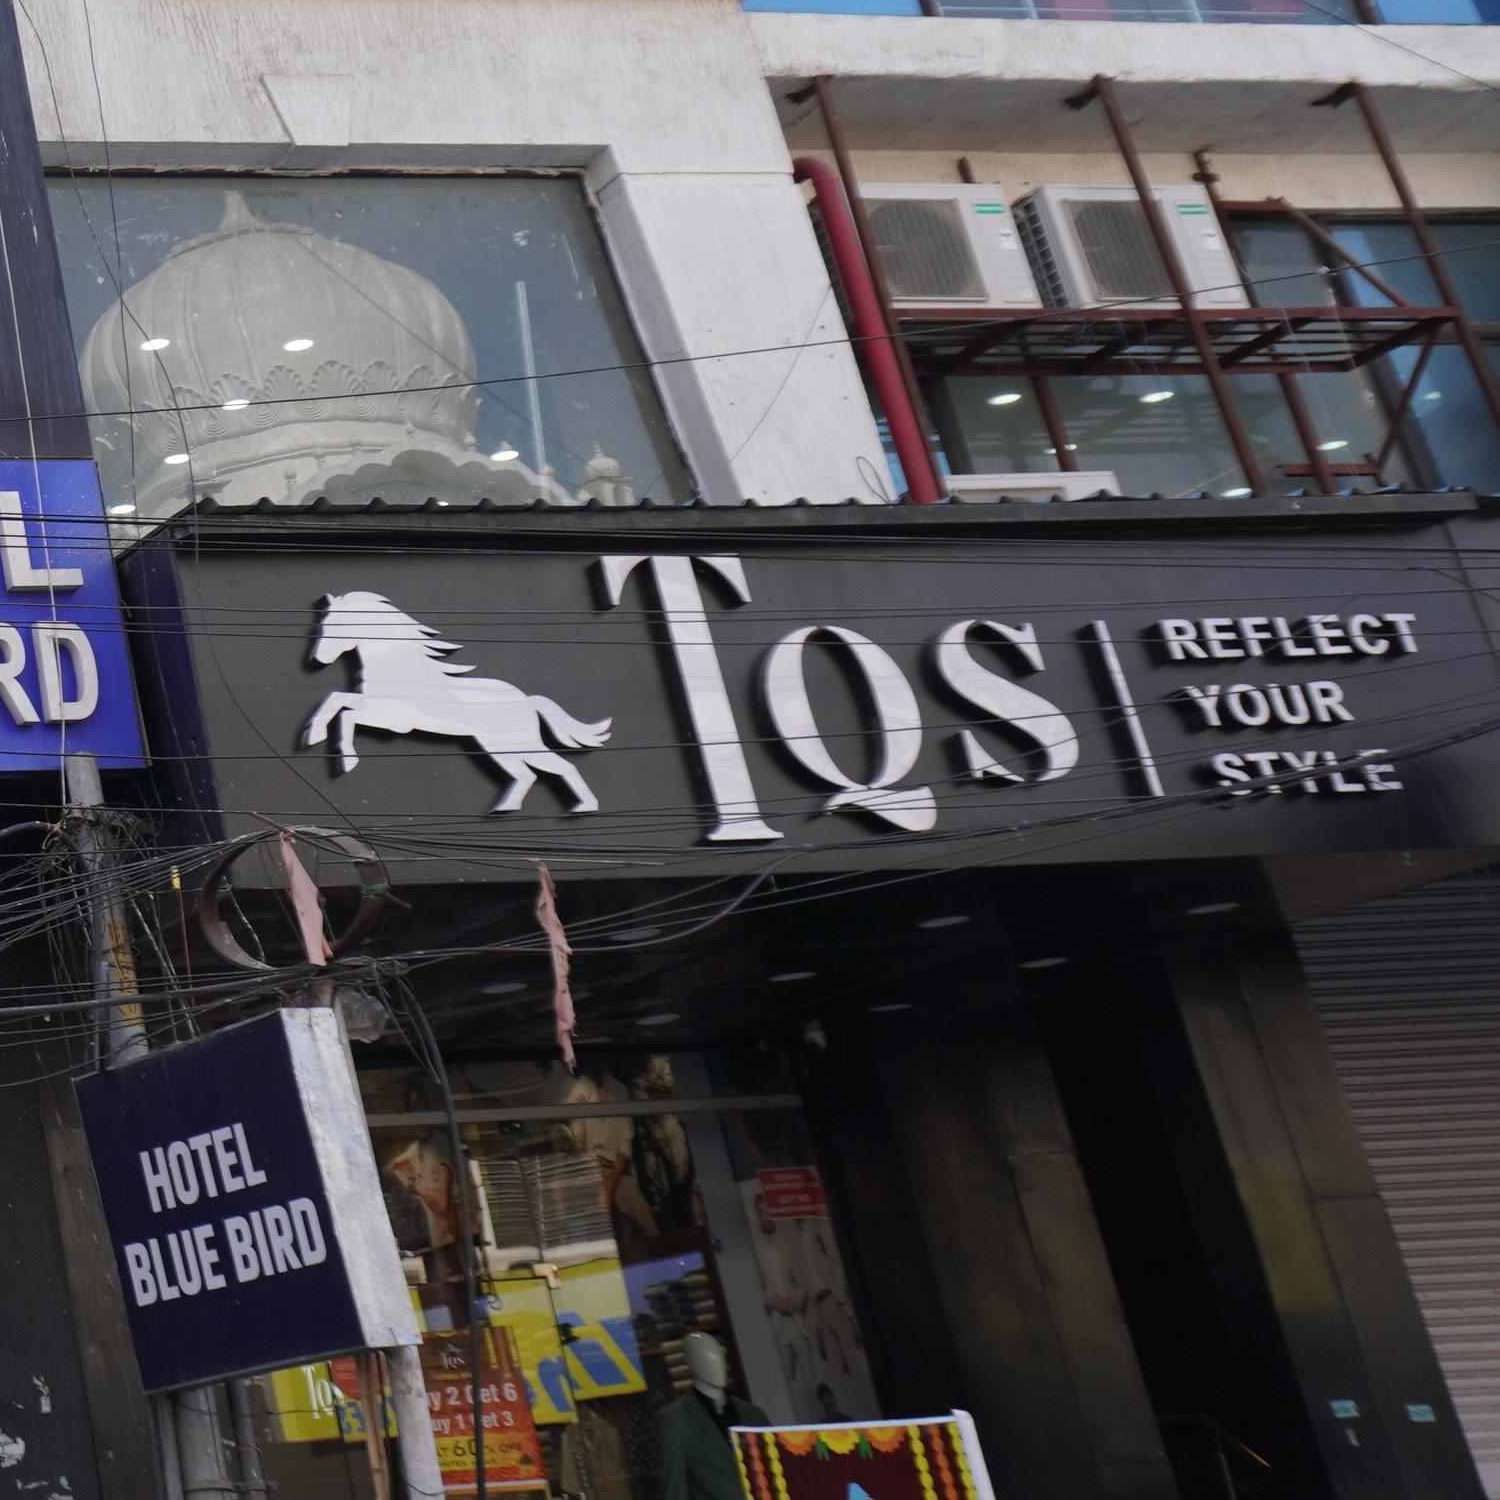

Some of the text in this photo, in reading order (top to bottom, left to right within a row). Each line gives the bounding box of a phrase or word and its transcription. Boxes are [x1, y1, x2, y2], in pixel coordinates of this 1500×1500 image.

[1158, 612, 1420, 661] REFLECT
[1182, 680, 1356, 727] YOUR
[1210, 748, 1404, 797] STYLE
[138, 1122, 268, 1214] HOTEL
[123, 1197, 328, 1307] BLUE BIRD
